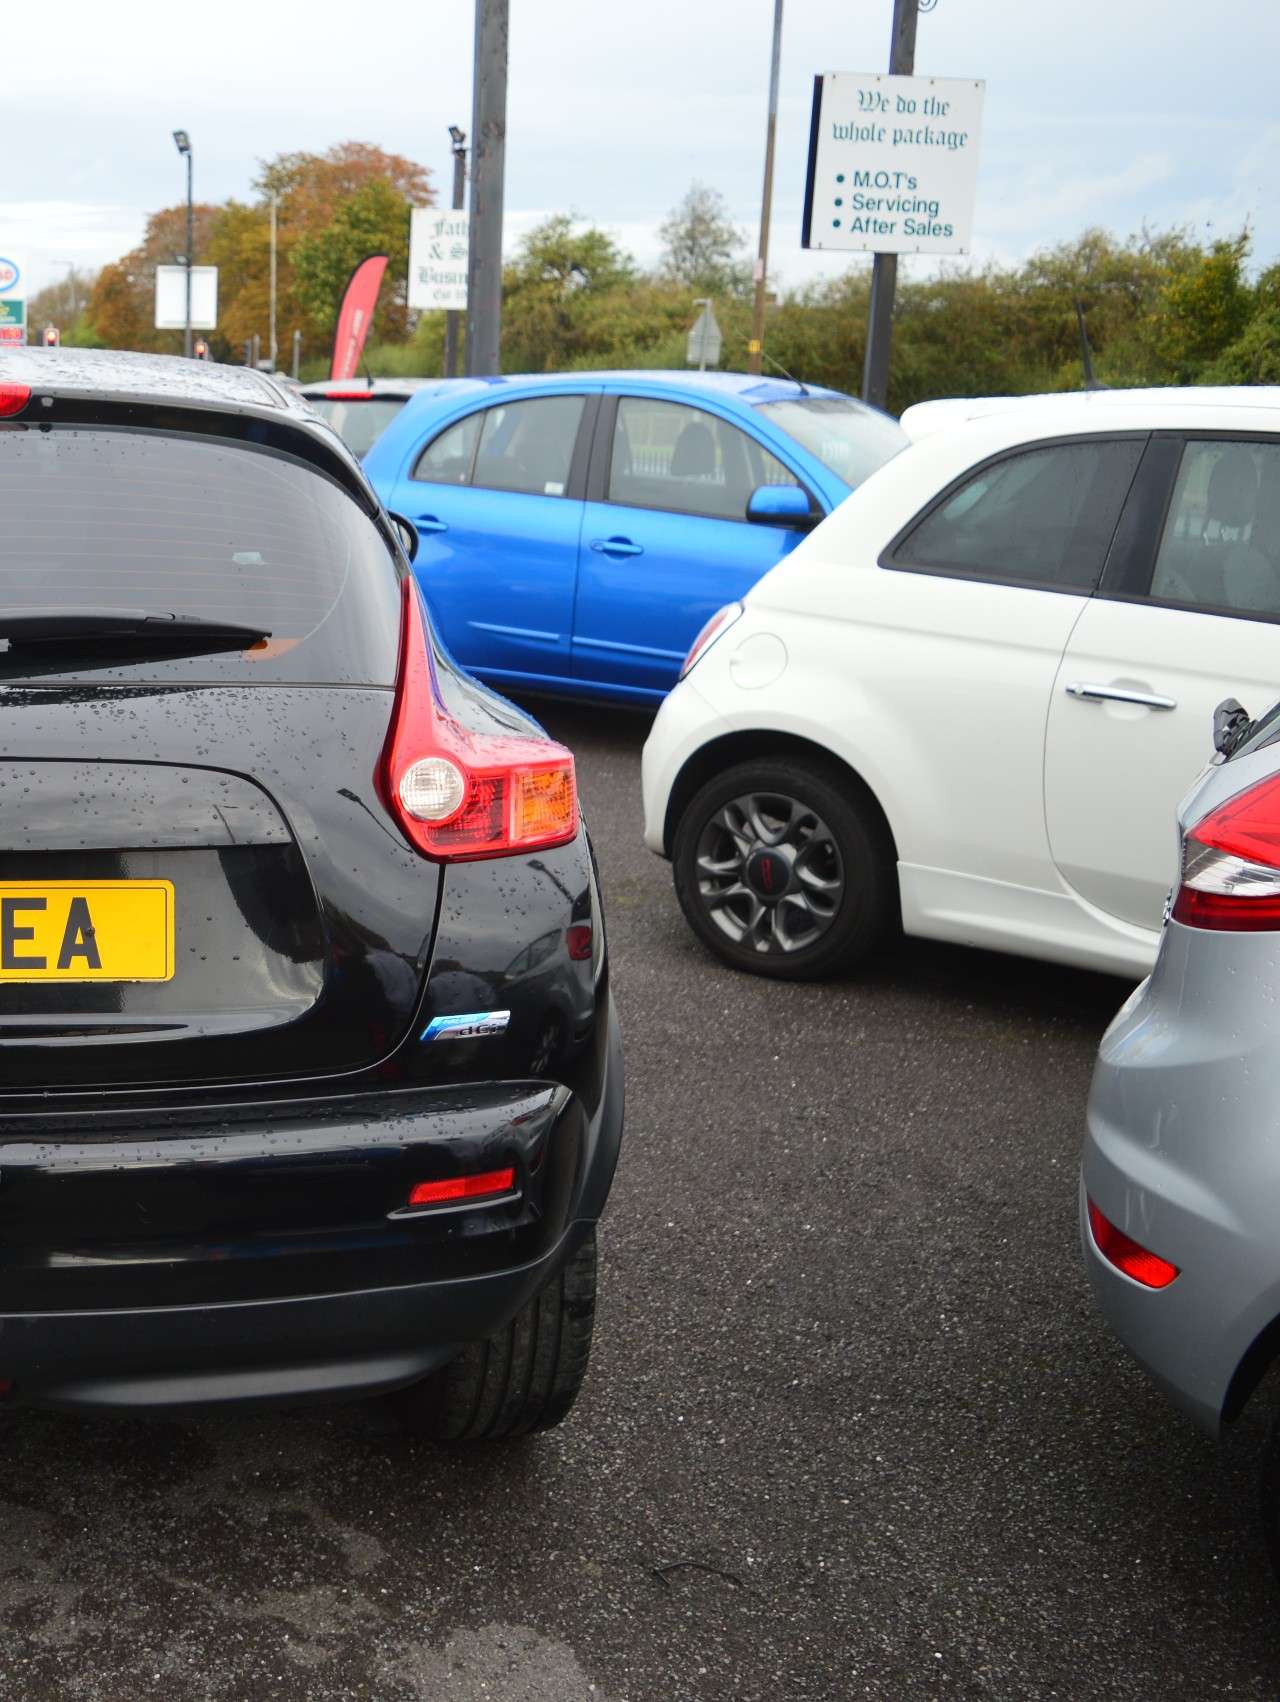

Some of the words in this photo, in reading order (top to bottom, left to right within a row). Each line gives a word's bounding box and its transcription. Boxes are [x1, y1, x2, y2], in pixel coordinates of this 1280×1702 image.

[857, 89, 890, 113] We
[896, 95, 916, 114] do
[923, 96, 951, 116] the
[832, 122, 886, 143] whole
[892, 125, 968, 150] package
[853, 171, 918, 190] M.O.T's
[852, 193, 940, 218] Servicing
[850, 216, 896, 234] After
[903, 218, 953, 237] Sales
